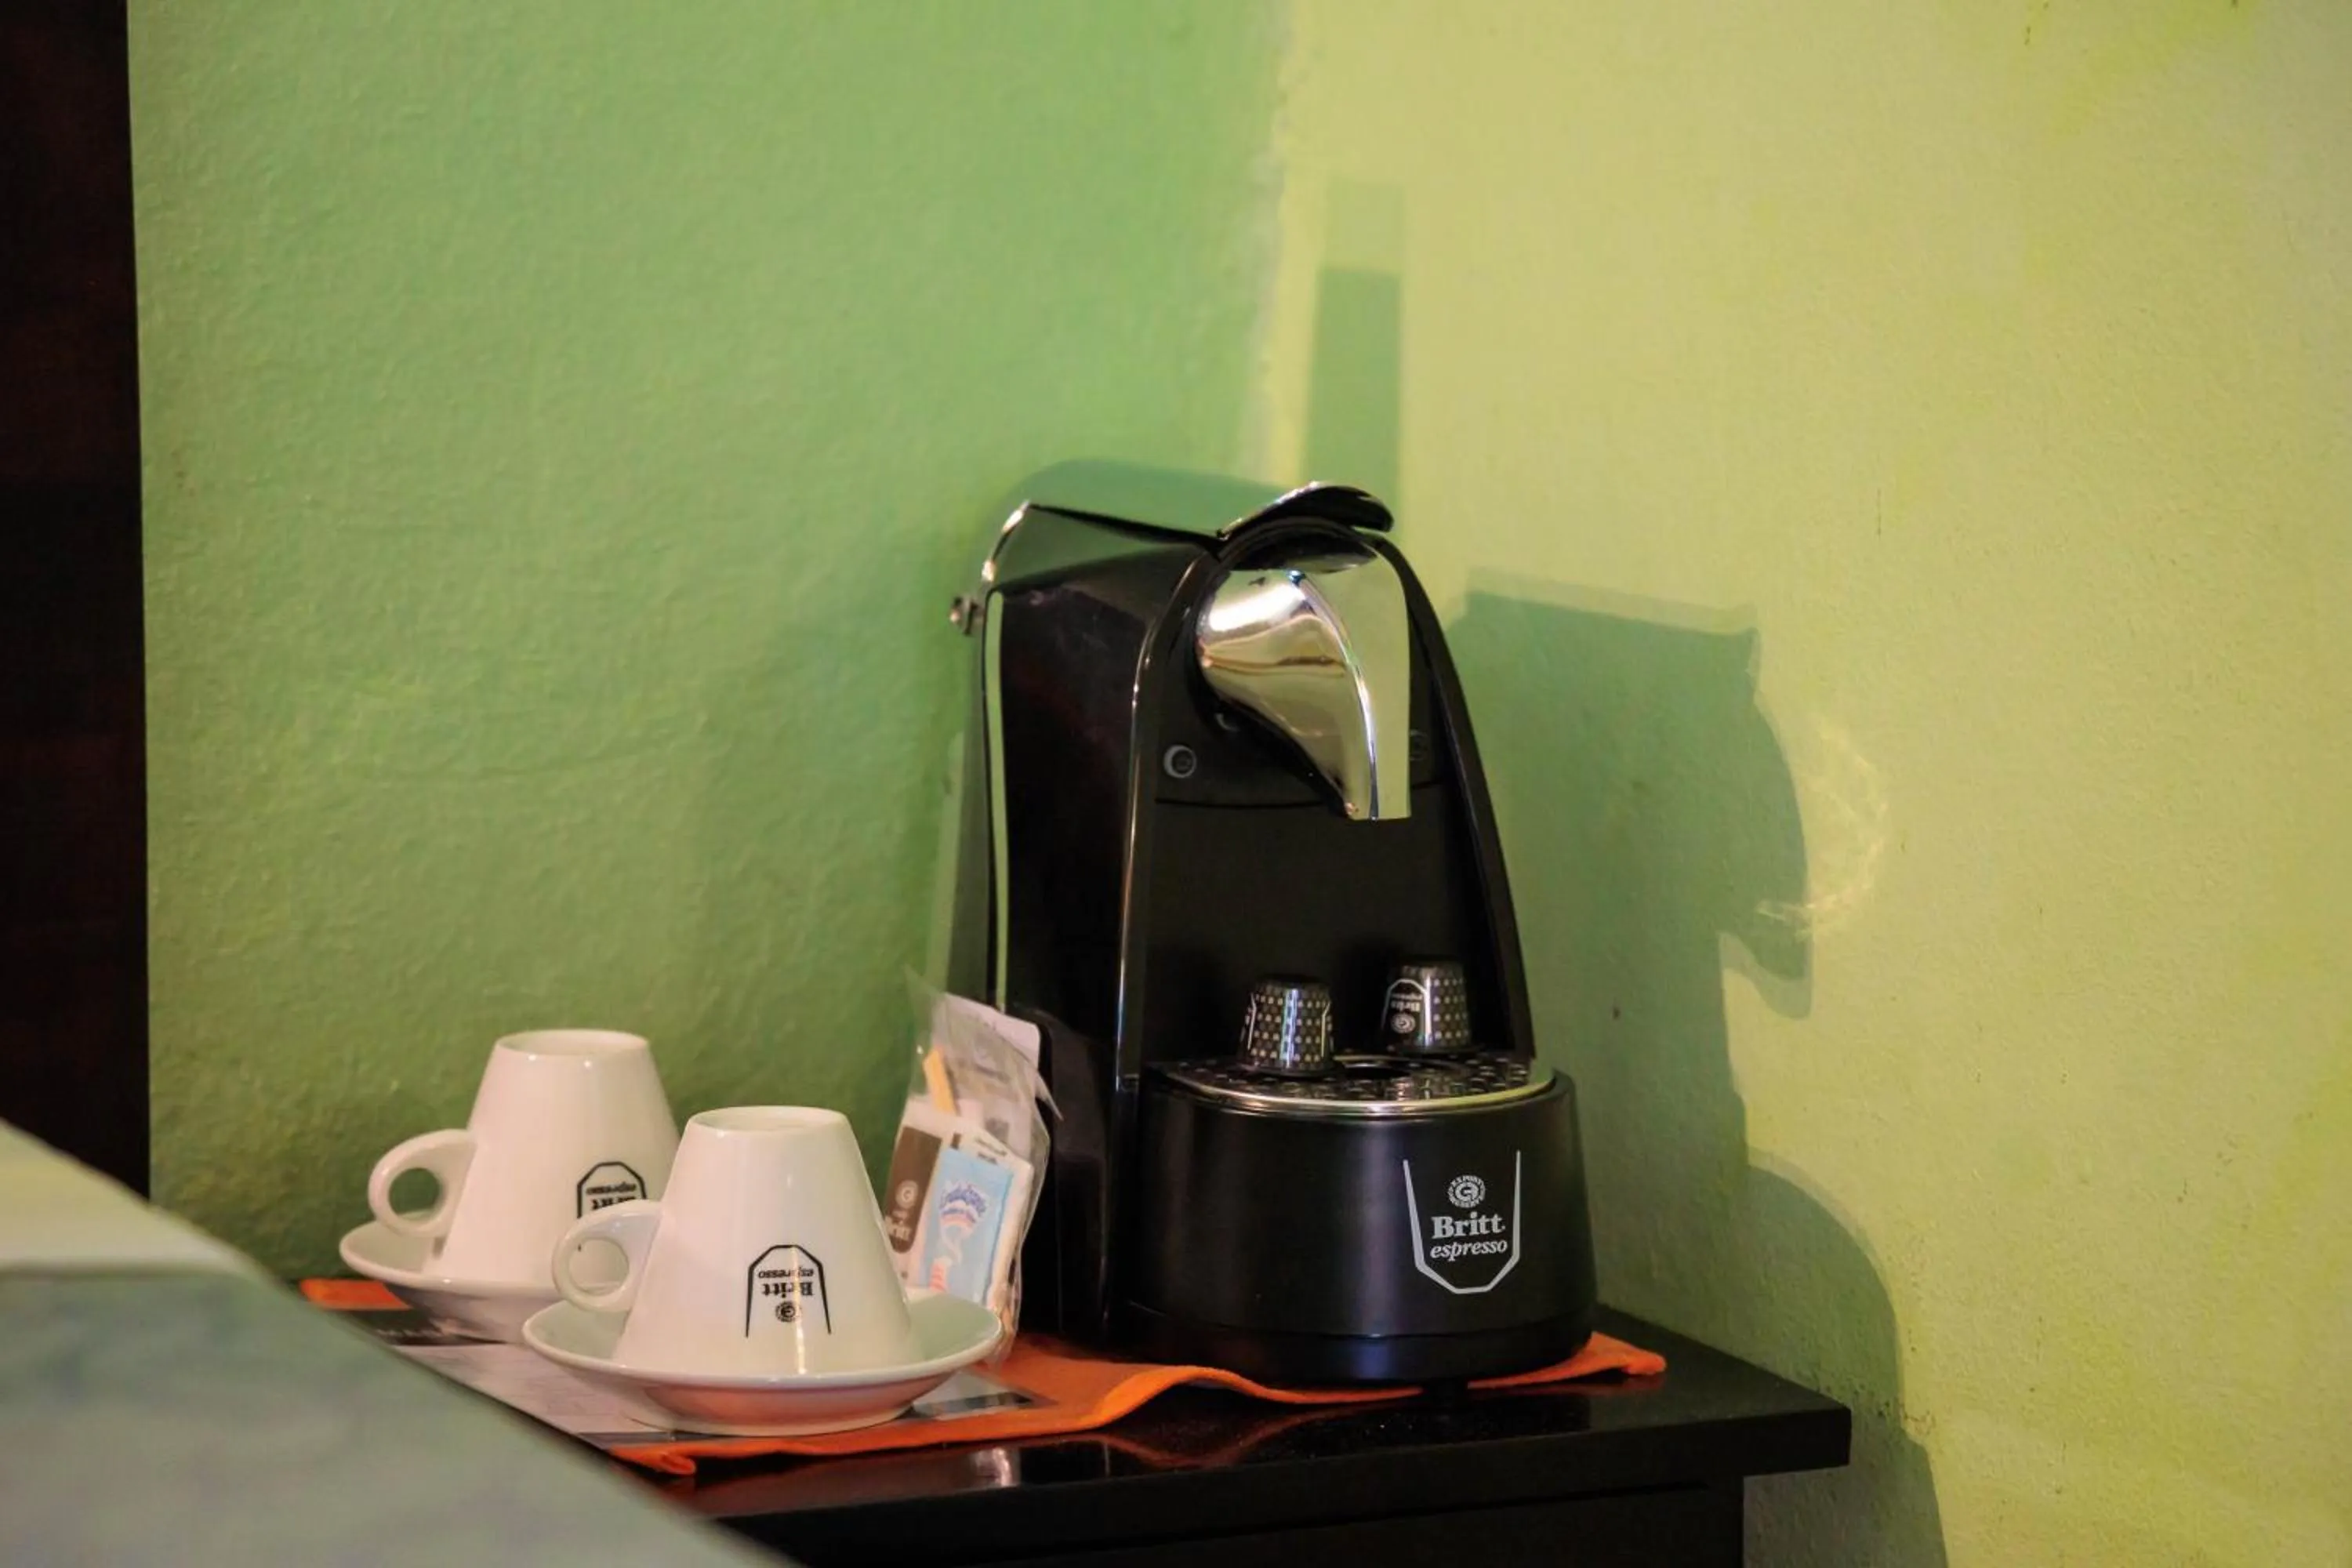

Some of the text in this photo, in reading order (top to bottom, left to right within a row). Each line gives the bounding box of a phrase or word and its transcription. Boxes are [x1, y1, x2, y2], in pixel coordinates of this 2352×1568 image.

[1431, 1211, 1504, 1239] Britt
[1430, 1240, 1508, 1261] espresso
[762, 1282, 814, 1298] Britt
